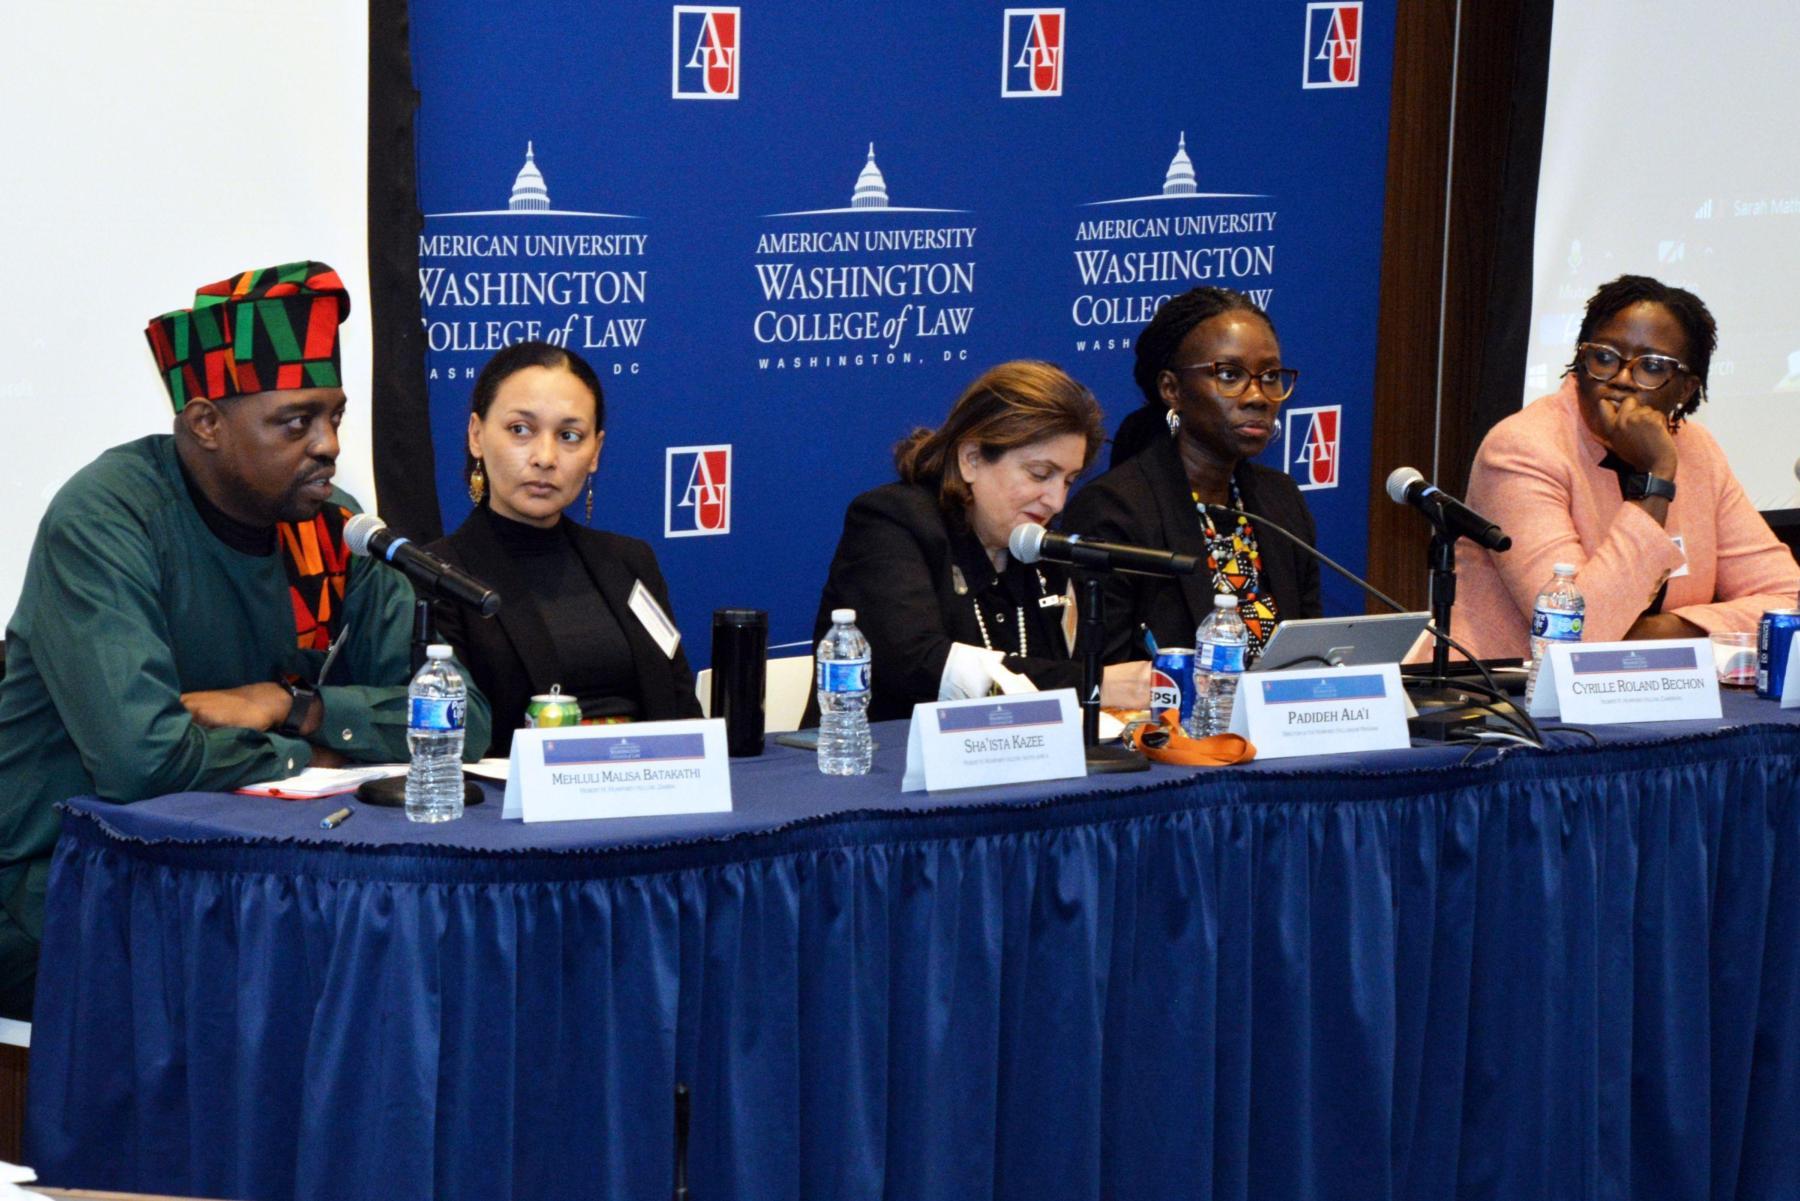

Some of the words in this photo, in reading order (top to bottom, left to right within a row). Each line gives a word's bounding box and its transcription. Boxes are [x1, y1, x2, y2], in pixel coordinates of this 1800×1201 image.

[1075, 217, 1169, 241] AMERICAN
[1175, 212, 1277, 236] UNIVERSITY
[419, 235, 518, 257] MERICAN
[525, 234, 647, 257] UNIVERSITY
[756, 231, 859, 254] AMERICAN
[865, 228, 977, 251] UNIVERSITY
[1074, 245, 1275, 285] WASHINGTON
[418, 267, 647, 307] WASHINGTON
[755, 262, 975, 301] WASHINGTON
[421, 318, 542, 352] OLLEGE
[546, 313, 579, 349] of
[583, 315, 647, 349] LAW
[753, 310, 880, 343] COLLEGE
[882, 304, 913, 349] of
[917, 305, 975, 337] LAW
[759, 353, 923, 369] WASHINGTON,
[943, 350, 967, 361] DC
[1152, 691, 1177, 705] PSI
[1572, 680, 1616, 696] CYRILLE
[1617, 678, 1660, 693] ROLAND
[1662, 677, 1705, 691] BECHON
[1288, 710, 1338, 725] PADIDEH
[964, 736, 1010, 754] SHA'ISTA
[1012, 734, 1046, 749] KAZEE
[552, 771, 600, 786] MEHLULI
[602, 770, 641, 784] MALISA
[643, 768, 701, 781] BATAKATHI
